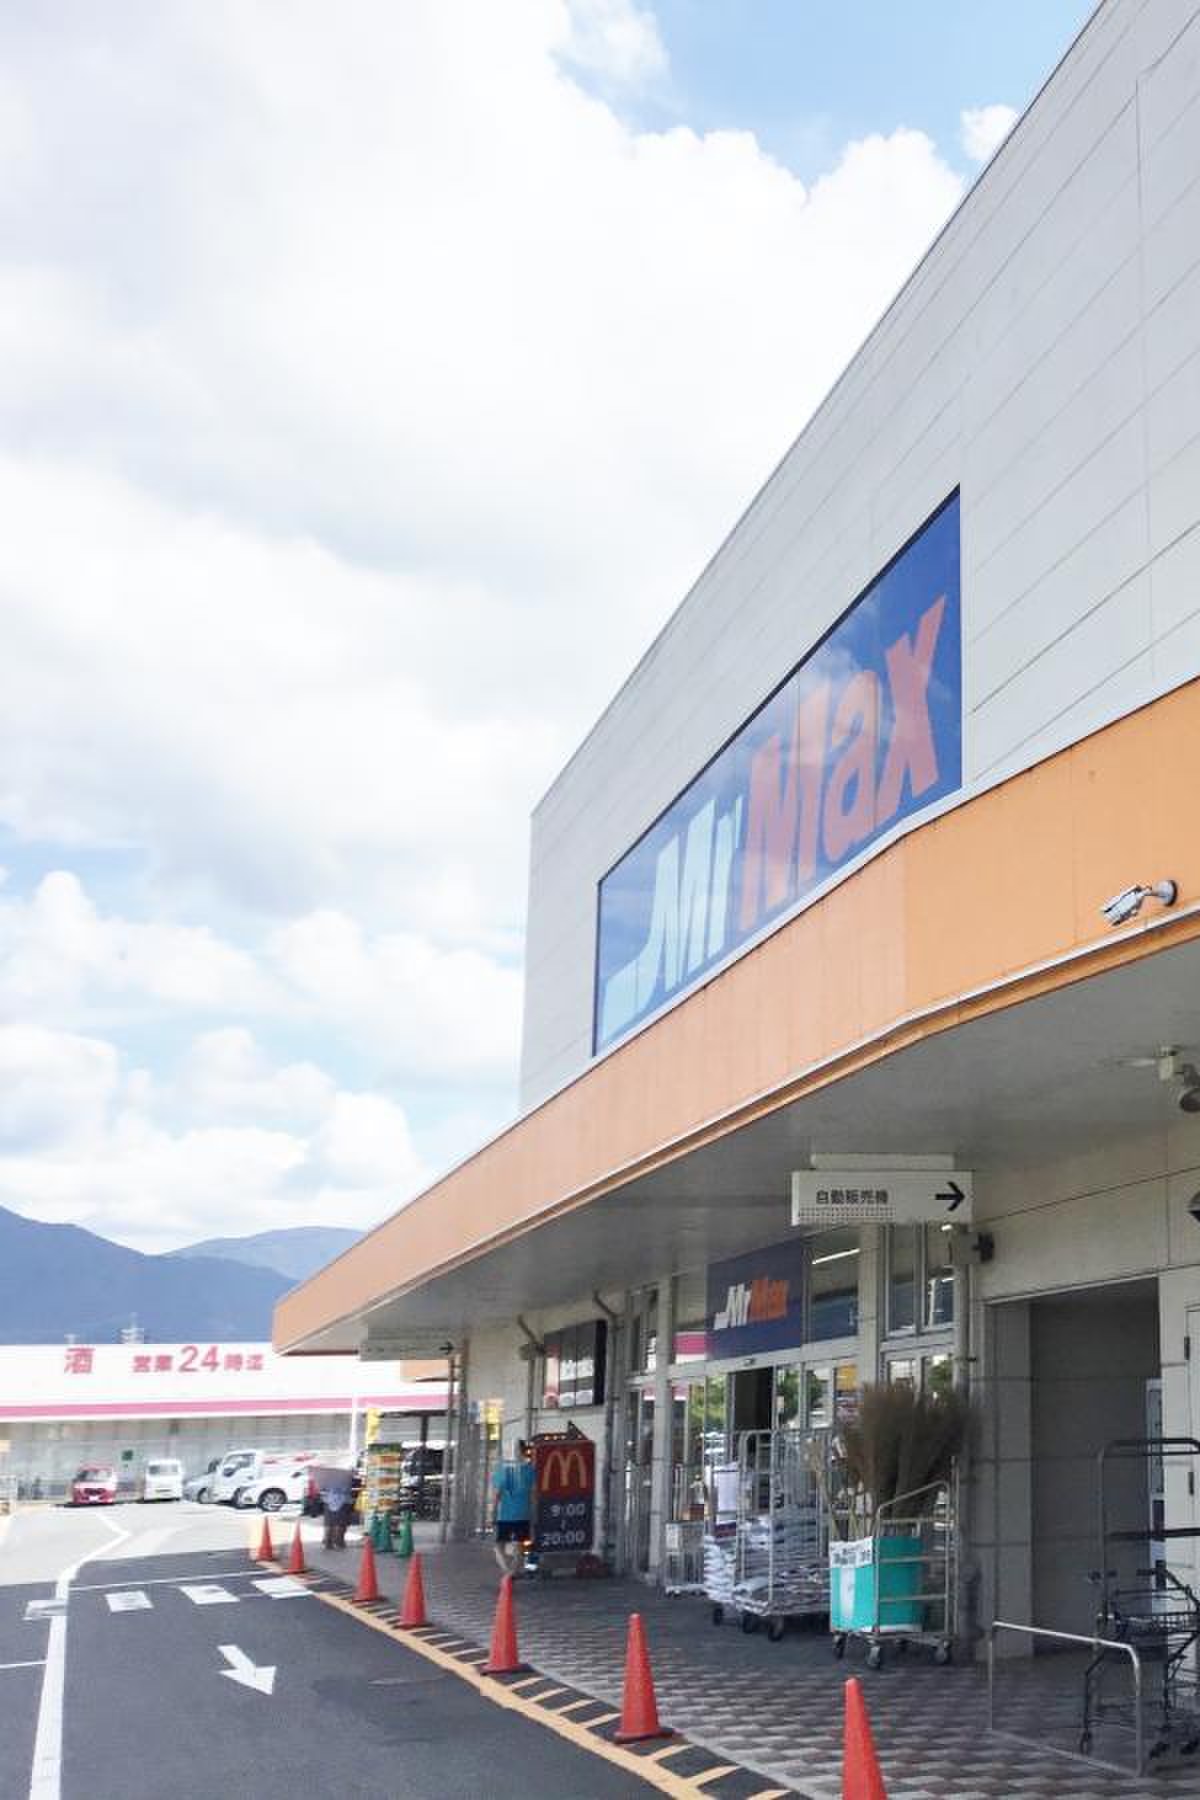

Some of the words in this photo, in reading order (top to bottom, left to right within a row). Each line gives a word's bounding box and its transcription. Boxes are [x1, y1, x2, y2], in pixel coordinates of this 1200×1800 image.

[816, 1188, 890, 1206] 自動販売機
